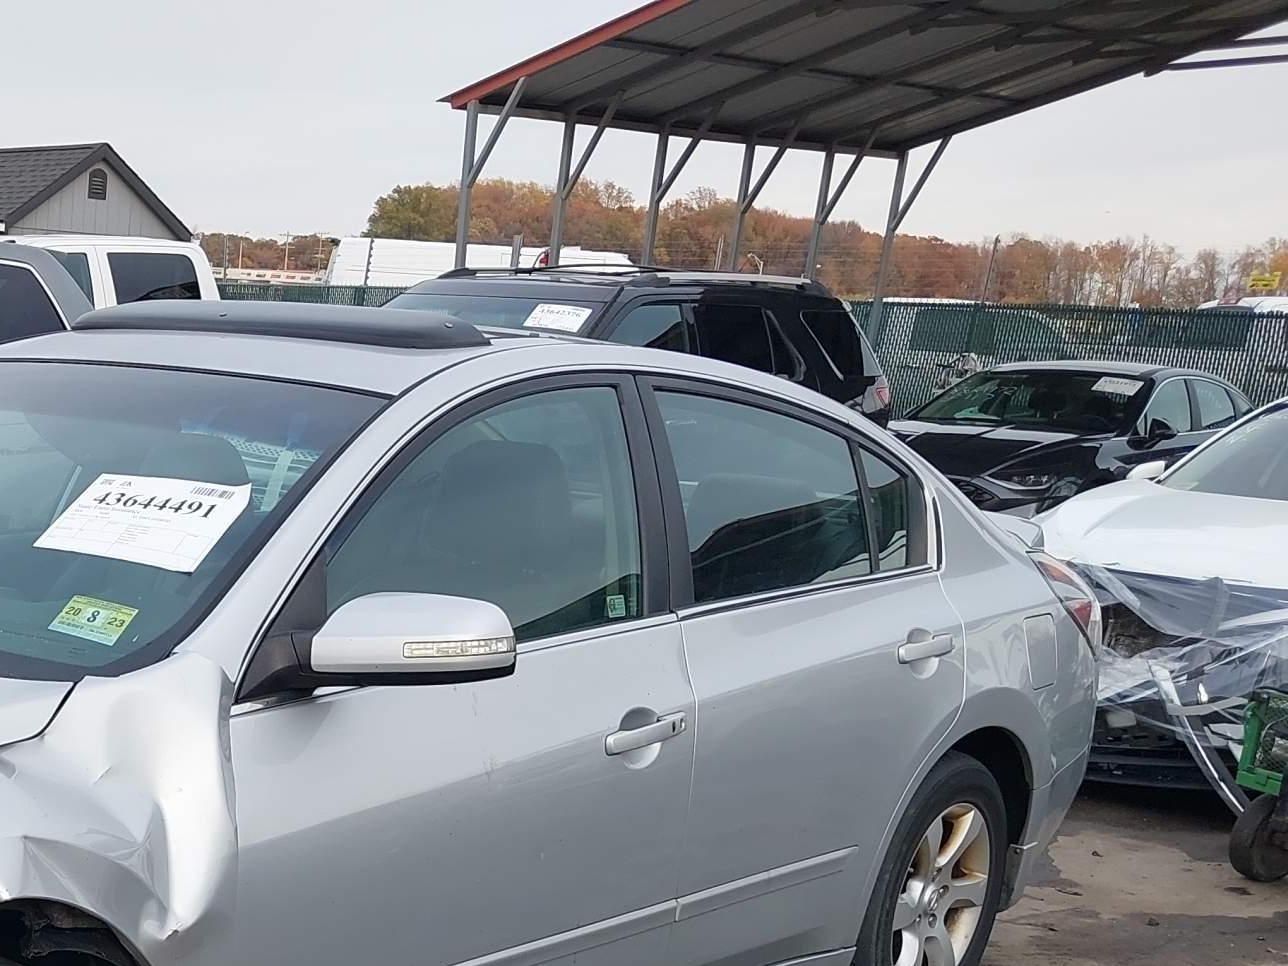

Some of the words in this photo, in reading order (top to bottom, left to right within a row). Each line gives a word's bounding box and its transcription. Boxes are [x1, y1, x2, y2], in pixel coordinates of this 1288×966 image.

[93, 491, 217, 518] 43644491
[65, 606, 82, 616] 20
[87, 609, 100, 623] 8
[107, 617, 126, 628] 23
